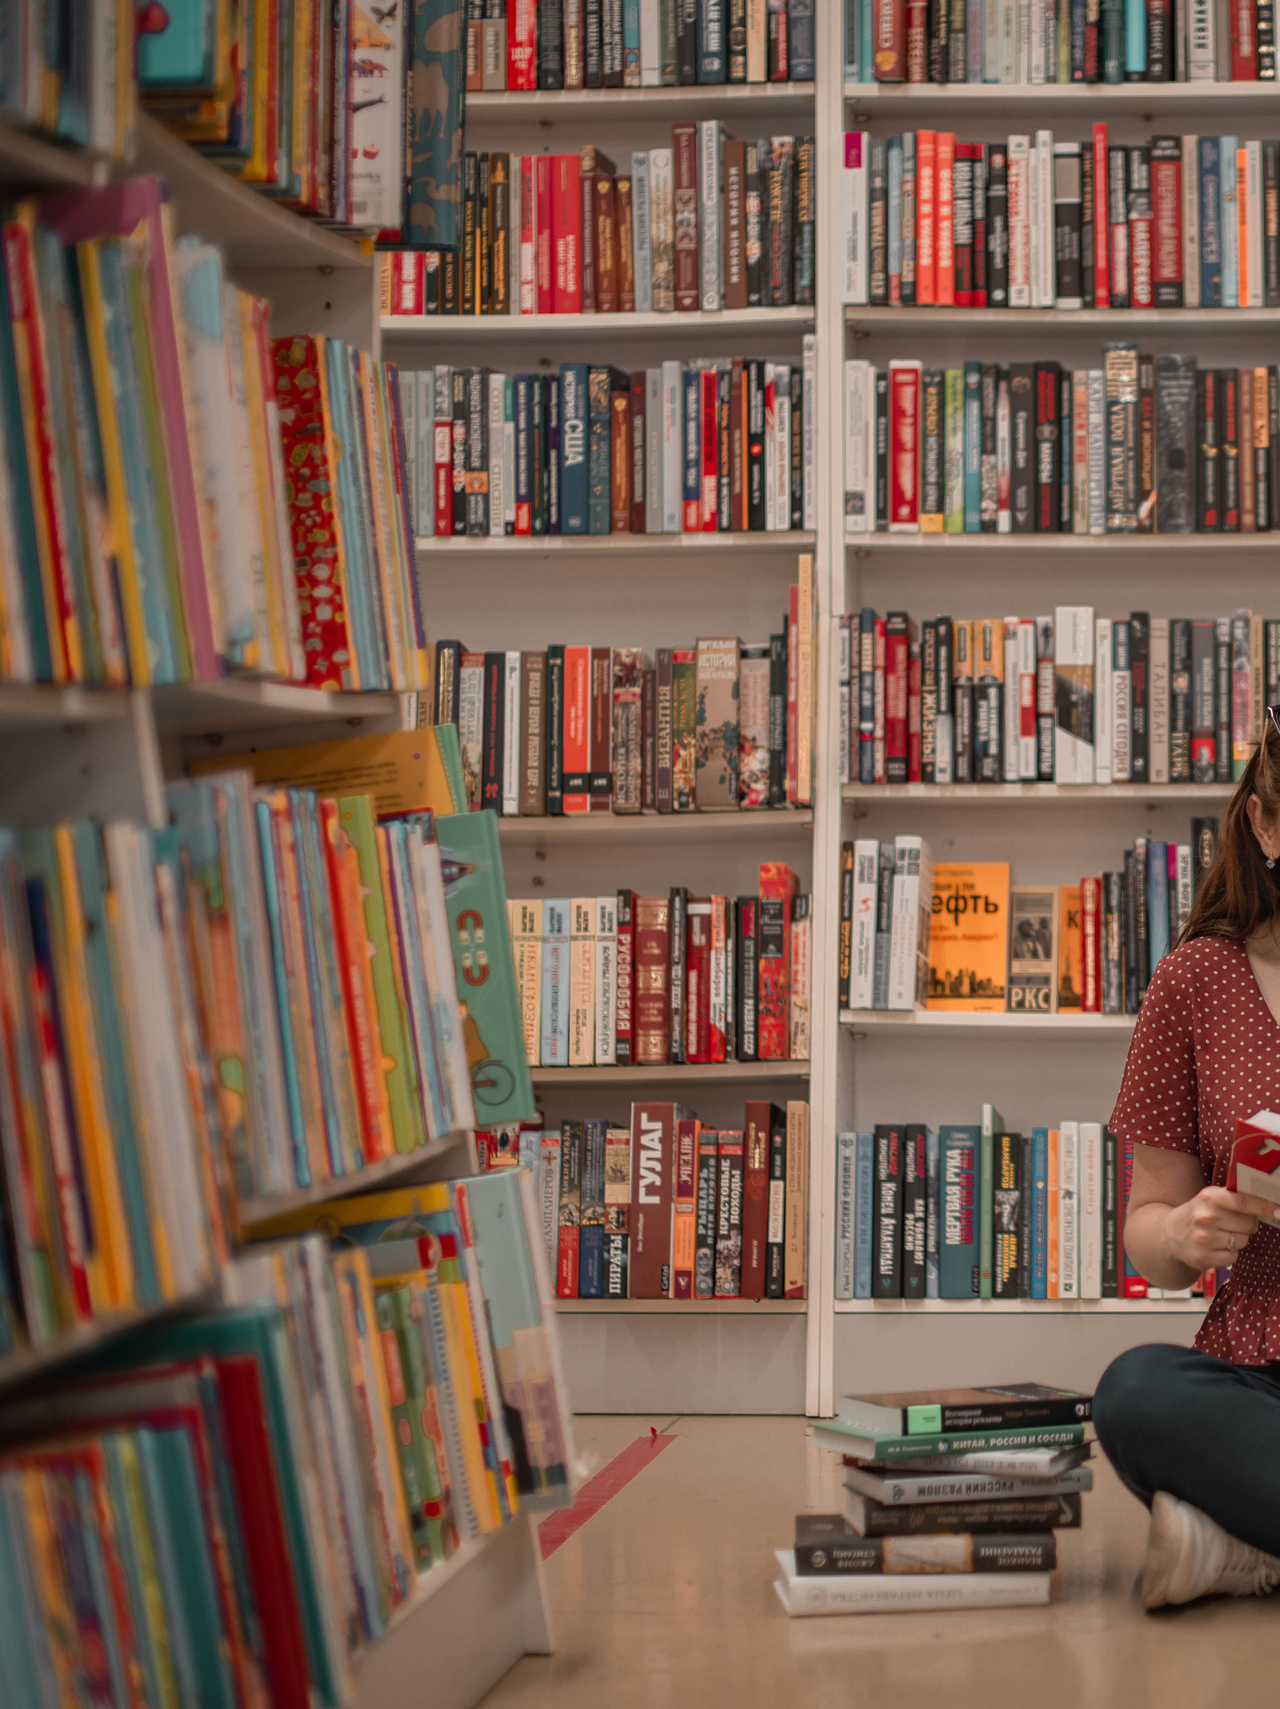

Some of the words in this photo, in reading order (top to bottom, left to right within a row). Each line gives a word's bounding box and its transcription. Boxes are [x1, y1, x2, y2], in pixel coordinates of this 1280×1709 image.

[565, 419, 584, 467] США
[1116, 675, 1127, 720] РОССИЯ
[1152, 662, 1165, 745] ТАЛИБАН
[658, 685, 671, 769] ВИЗАНТИЯ
[1114, 723, 1127, 773] СЕГОДНЯ
[1171, 732, 1183, 777] ЦАРЬ
[932, 889, 999, 926] ефть
[617, 933, 631, 1031] РУСОФОБИЯ
[638, 1111, 663, 1205] ГУЛАГ
[879, 1138, 888, 1180] ХИНШТЕЙН
[889, 1132, 898, 1176] АЛЕКСАНДР
[906, 1140, 916, 1183] ХИНШТЕЙН
[916, 1134, 925, 1178] АЛЕКСАНДР
[946, 1149, 961, 1183] РУКА
[959, 1147, 974, 1171] THE
[1002, 1136, 1010, 1189] ШАМБАРОВ
[698, 1167, 708, 1236] РЫЦАРЬ
[719, 1158, 730, 1235] КРЕСТОВЫЕ
[730, 1169, 742, 1224] ПОХОДЫ
[914, 1199, 925, 1218] КАК
[959, 1172, 974, 1206] DEAD
[905, 1213, 915, 1251] РОССИЮ
[946, 1185, 961, 1245] МЕРТВАЯ
[958, 1208, 974, 1245] HAND
[609, 1235, 622, 1294] ПИРАТЫ
[914, 1221, 925, 1266] УБИВАЮТ
[952, 1437, 988, 1450] КИТАЙ,
[990, 1434, 1027, 1446] РОССИЯ
[1028, 1433, 1036, 1443] И
[1037, 1431, 1074, 1444] СОСЕДИ
[916, 1483, 962, 1498] РАЗЛОМ
[965, 1479, 1015, 1496] РУССКИЙ
